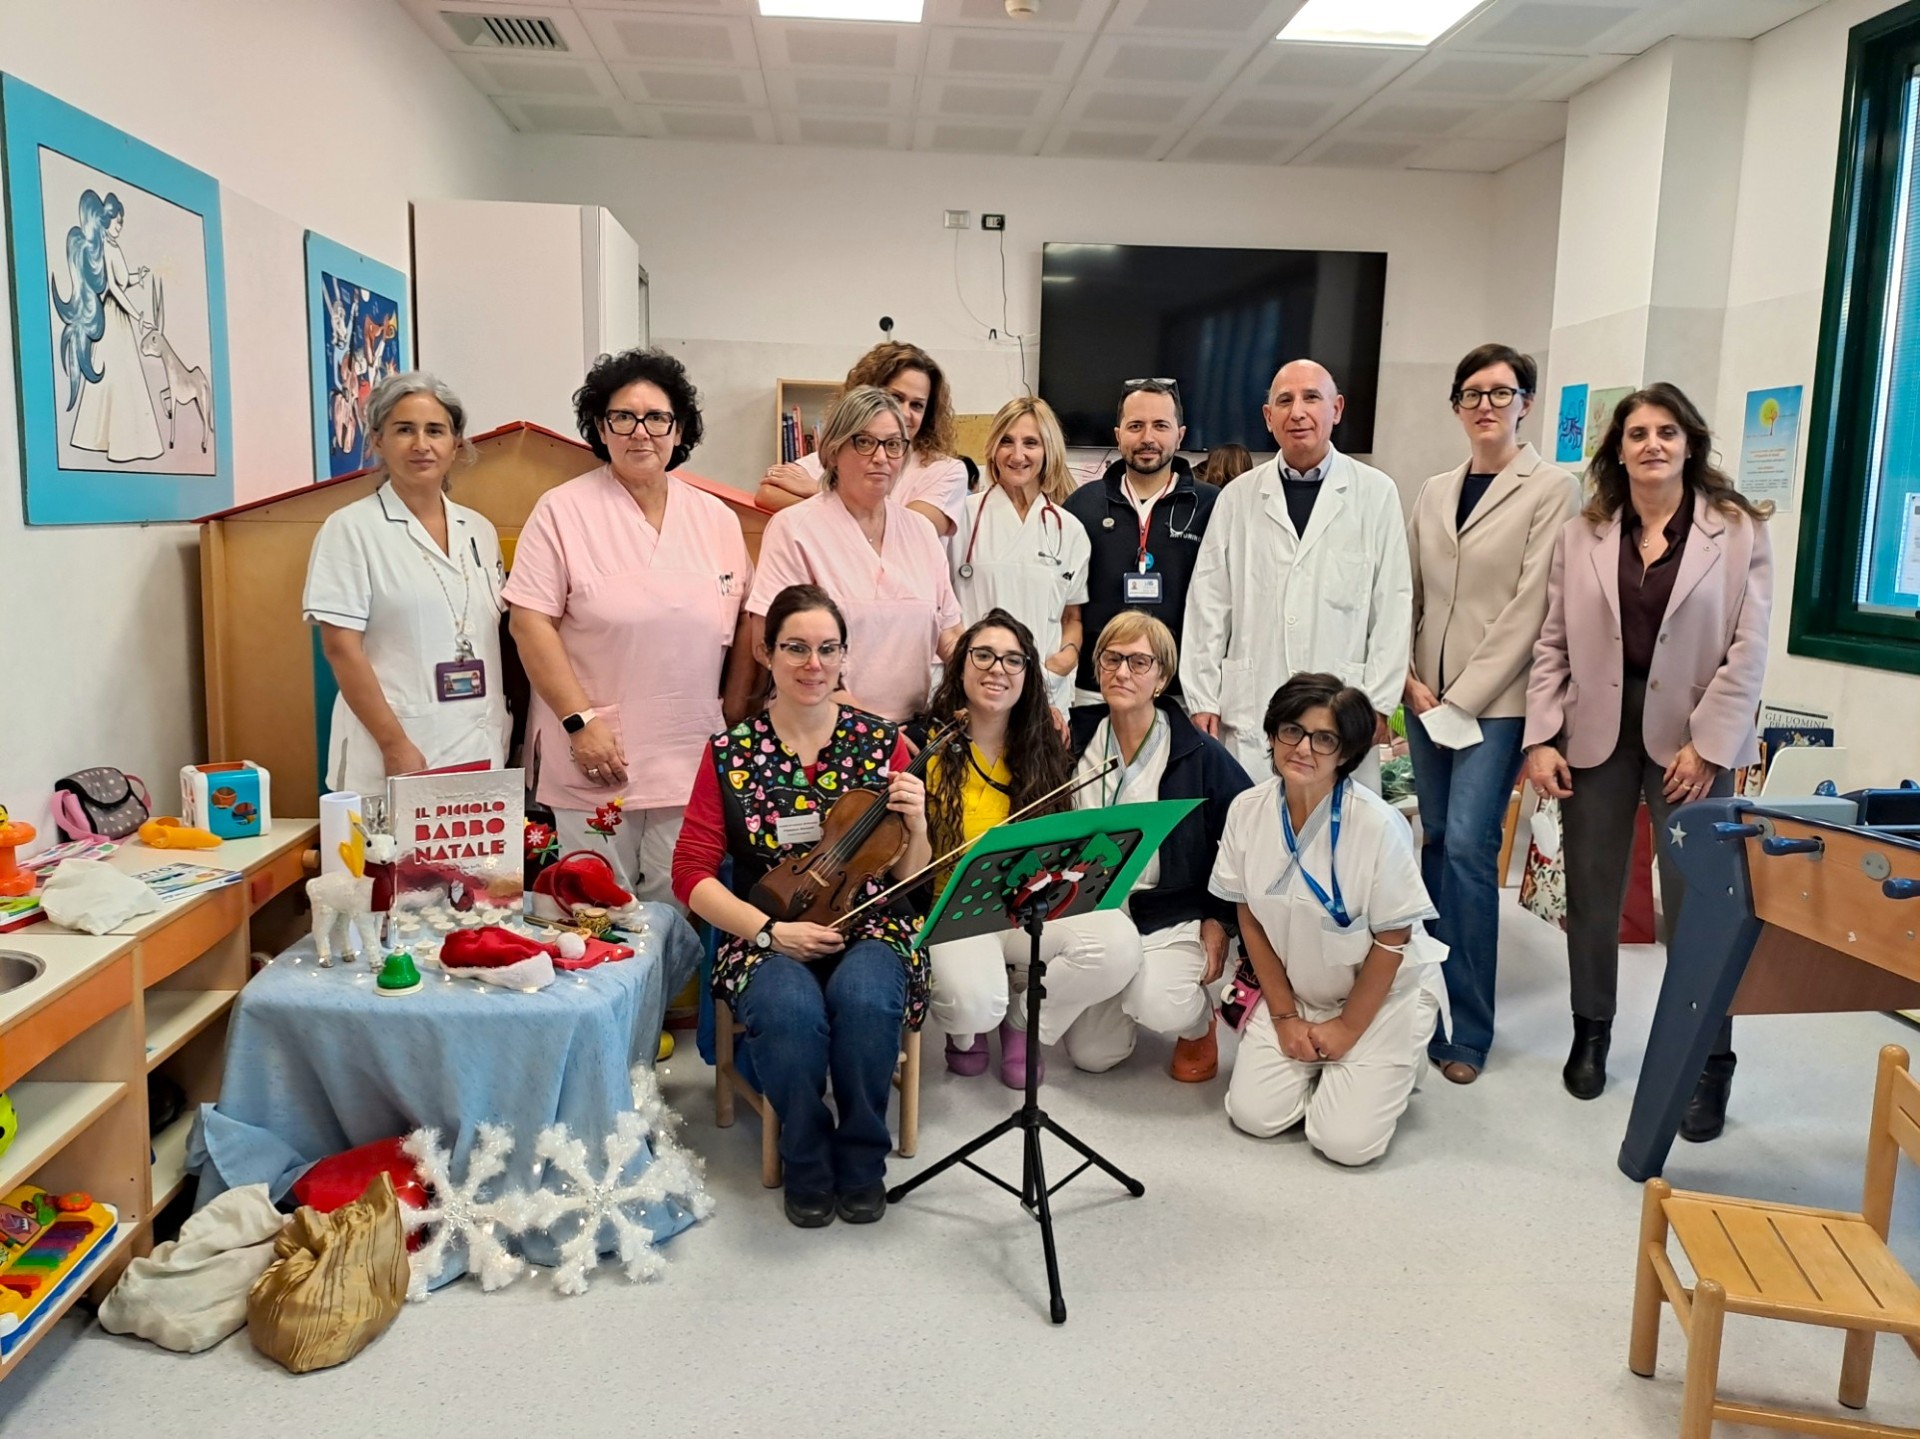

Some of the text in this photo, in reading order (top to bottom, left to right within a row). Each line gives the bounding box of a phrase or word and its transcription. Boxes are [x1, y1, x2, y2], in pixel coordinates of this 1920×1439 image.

[1765, 712, 1782, 722] GLI
[1785, 715, 1826, 729] UOMINI
[415, 801, 506, 819] IL PICCOLO
[415, 817, 506, 842] BABBO
[414, 839, 506, 864] NATALE
